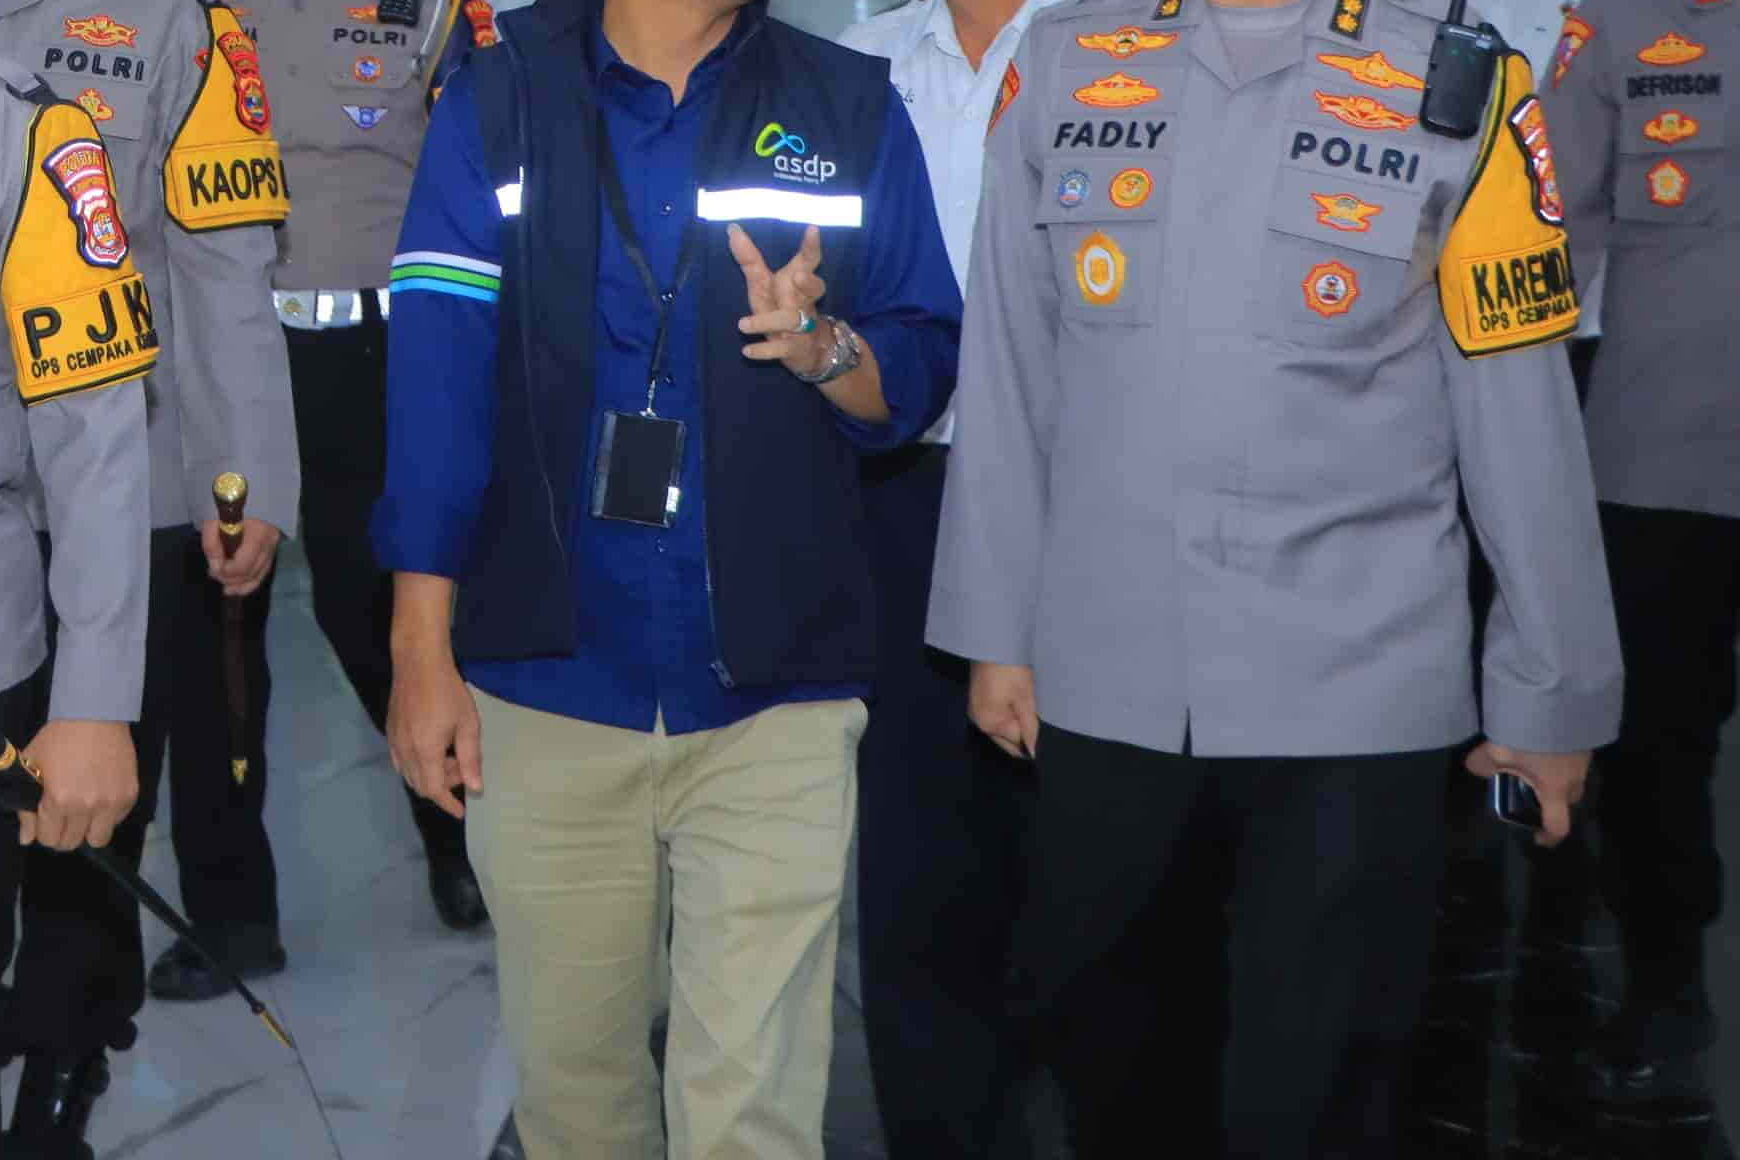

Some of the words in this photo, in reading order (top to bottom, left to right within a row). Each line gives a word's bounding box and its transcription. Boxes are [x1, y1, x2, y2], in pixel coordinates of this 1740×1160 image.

[333, 27, 408, 46] POLRI
[44, 47, 145, 81] POLRI
[1627, 73, 1721, 99] DEFRISON
[1053, 120, 1167, 150] FADLY
[774, 154, 837, 183] asdp
[1290, 130, 1420, 183] POLRI
[187, 157, 278, 207] KAOPS
[1479, 311, 1510, 333] OPS
[31, 357, 60, 379] OPS
[66, 339, 134, 371] CEMPAKA
